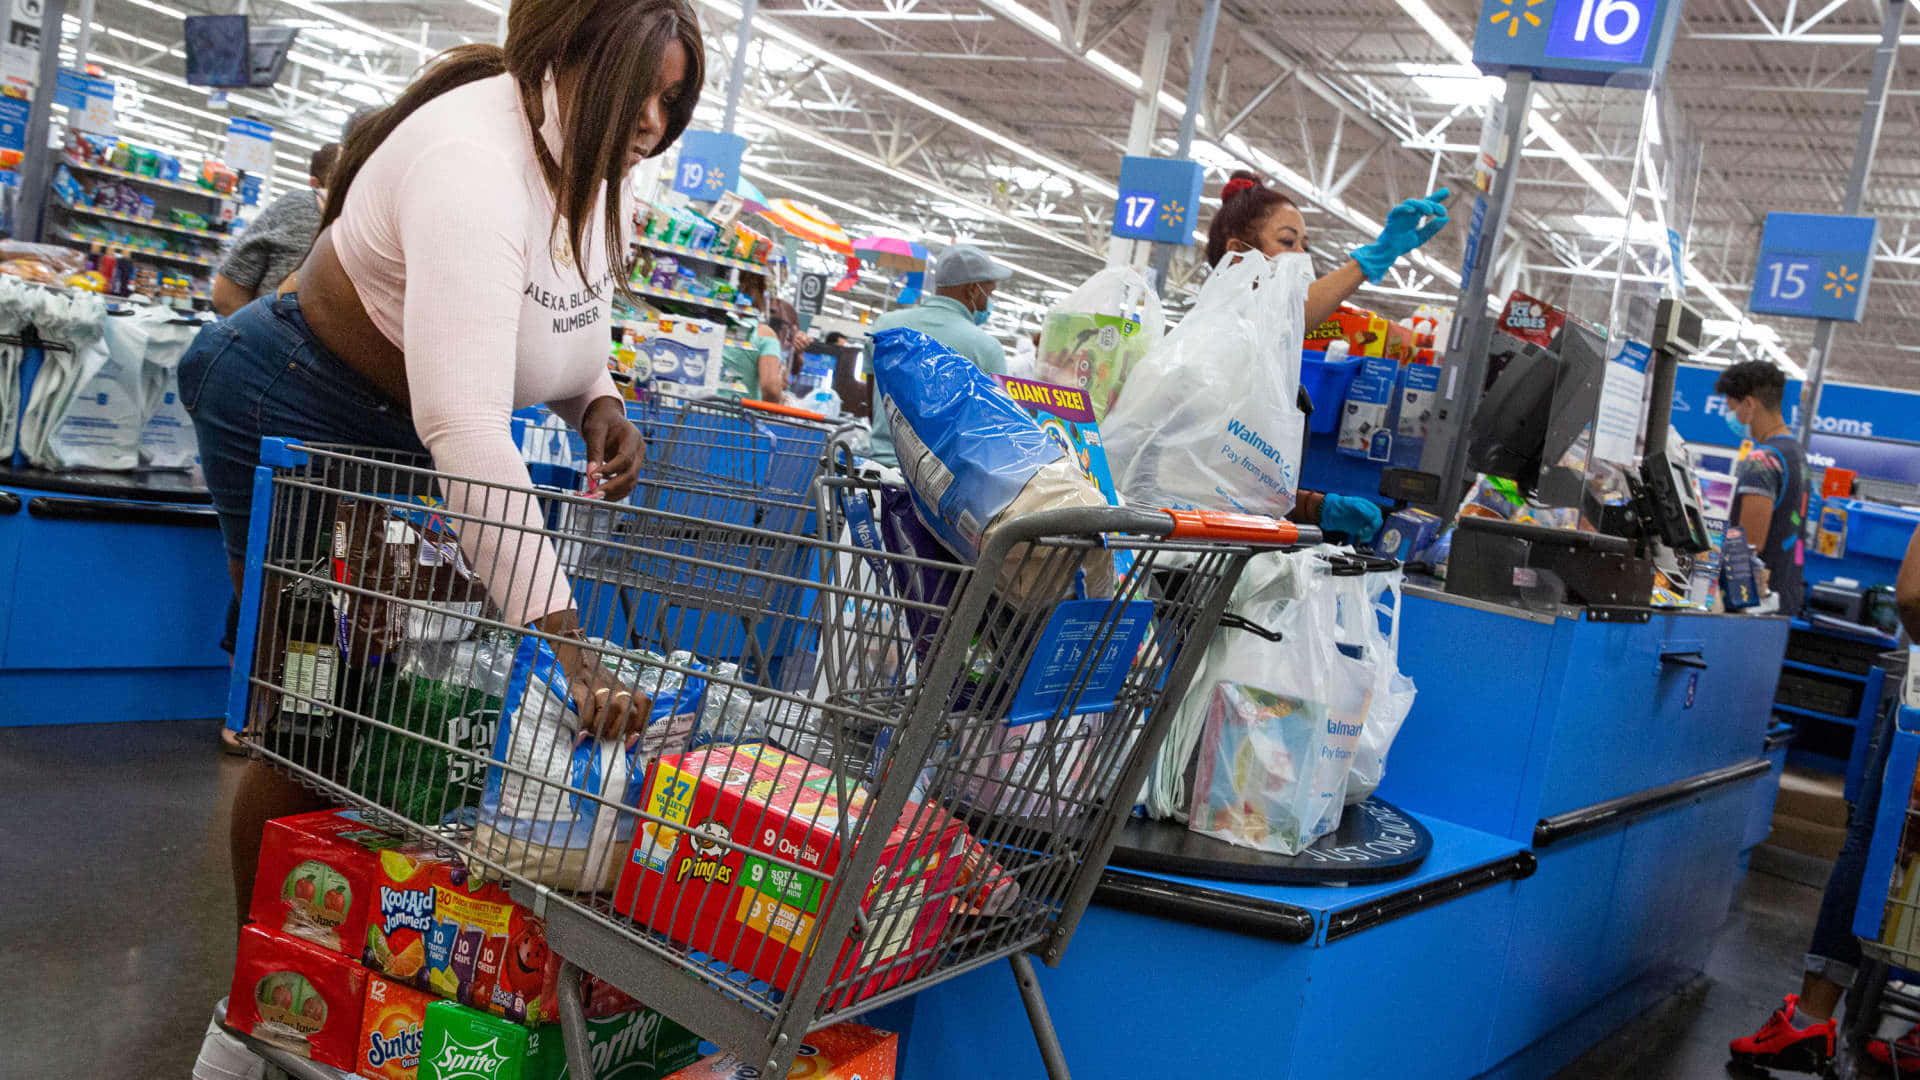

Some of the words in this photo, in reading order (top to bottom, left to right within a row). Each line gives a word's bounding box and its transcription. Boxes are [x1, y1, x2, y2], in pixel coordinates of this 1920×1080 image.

[1573, 0, 1641, 46] 16
[682, 162, 705, 189] 19
[1124, 196, 1156, 229] 17
[1768, 261, 1809, 299] 15
[525, 281, 568, 312] ALEXA,
[552, 306, 600, 334] NUMBER
[1506, 315, 1547, 329] CUBES
[1005, 379, 1053, 406] GIANT
[1050, 387, 1086, 411] SIZE!
[1220, 443, 1241, 464] Pay
[1240, 455, 1263, 477] from
[662, 776, 691, 802] 27
[763, 828, 777, 847] 9
[1303, 845, 1382, 862] JUST
[751, 863, 764, 882] 9
[380, 885, 435, 917] Kool-Aid
[438, 890, 453, 905] 30
[750, 900, 762, 918] 9
[384, 911, 432, 935] Jammers
[433, 930, 444, 945] 10
[458, 938, 470, 954] 10
[483, 947, 495, 963] 10
[370, 980, 387, 997] 12
[368, 1029, 424, 1068] Sunkis
[527, 1032, 540, 1050] 12
[401, 1056, 420, 1069] Oran
[437, 1045, 497, 1073] Sprite
